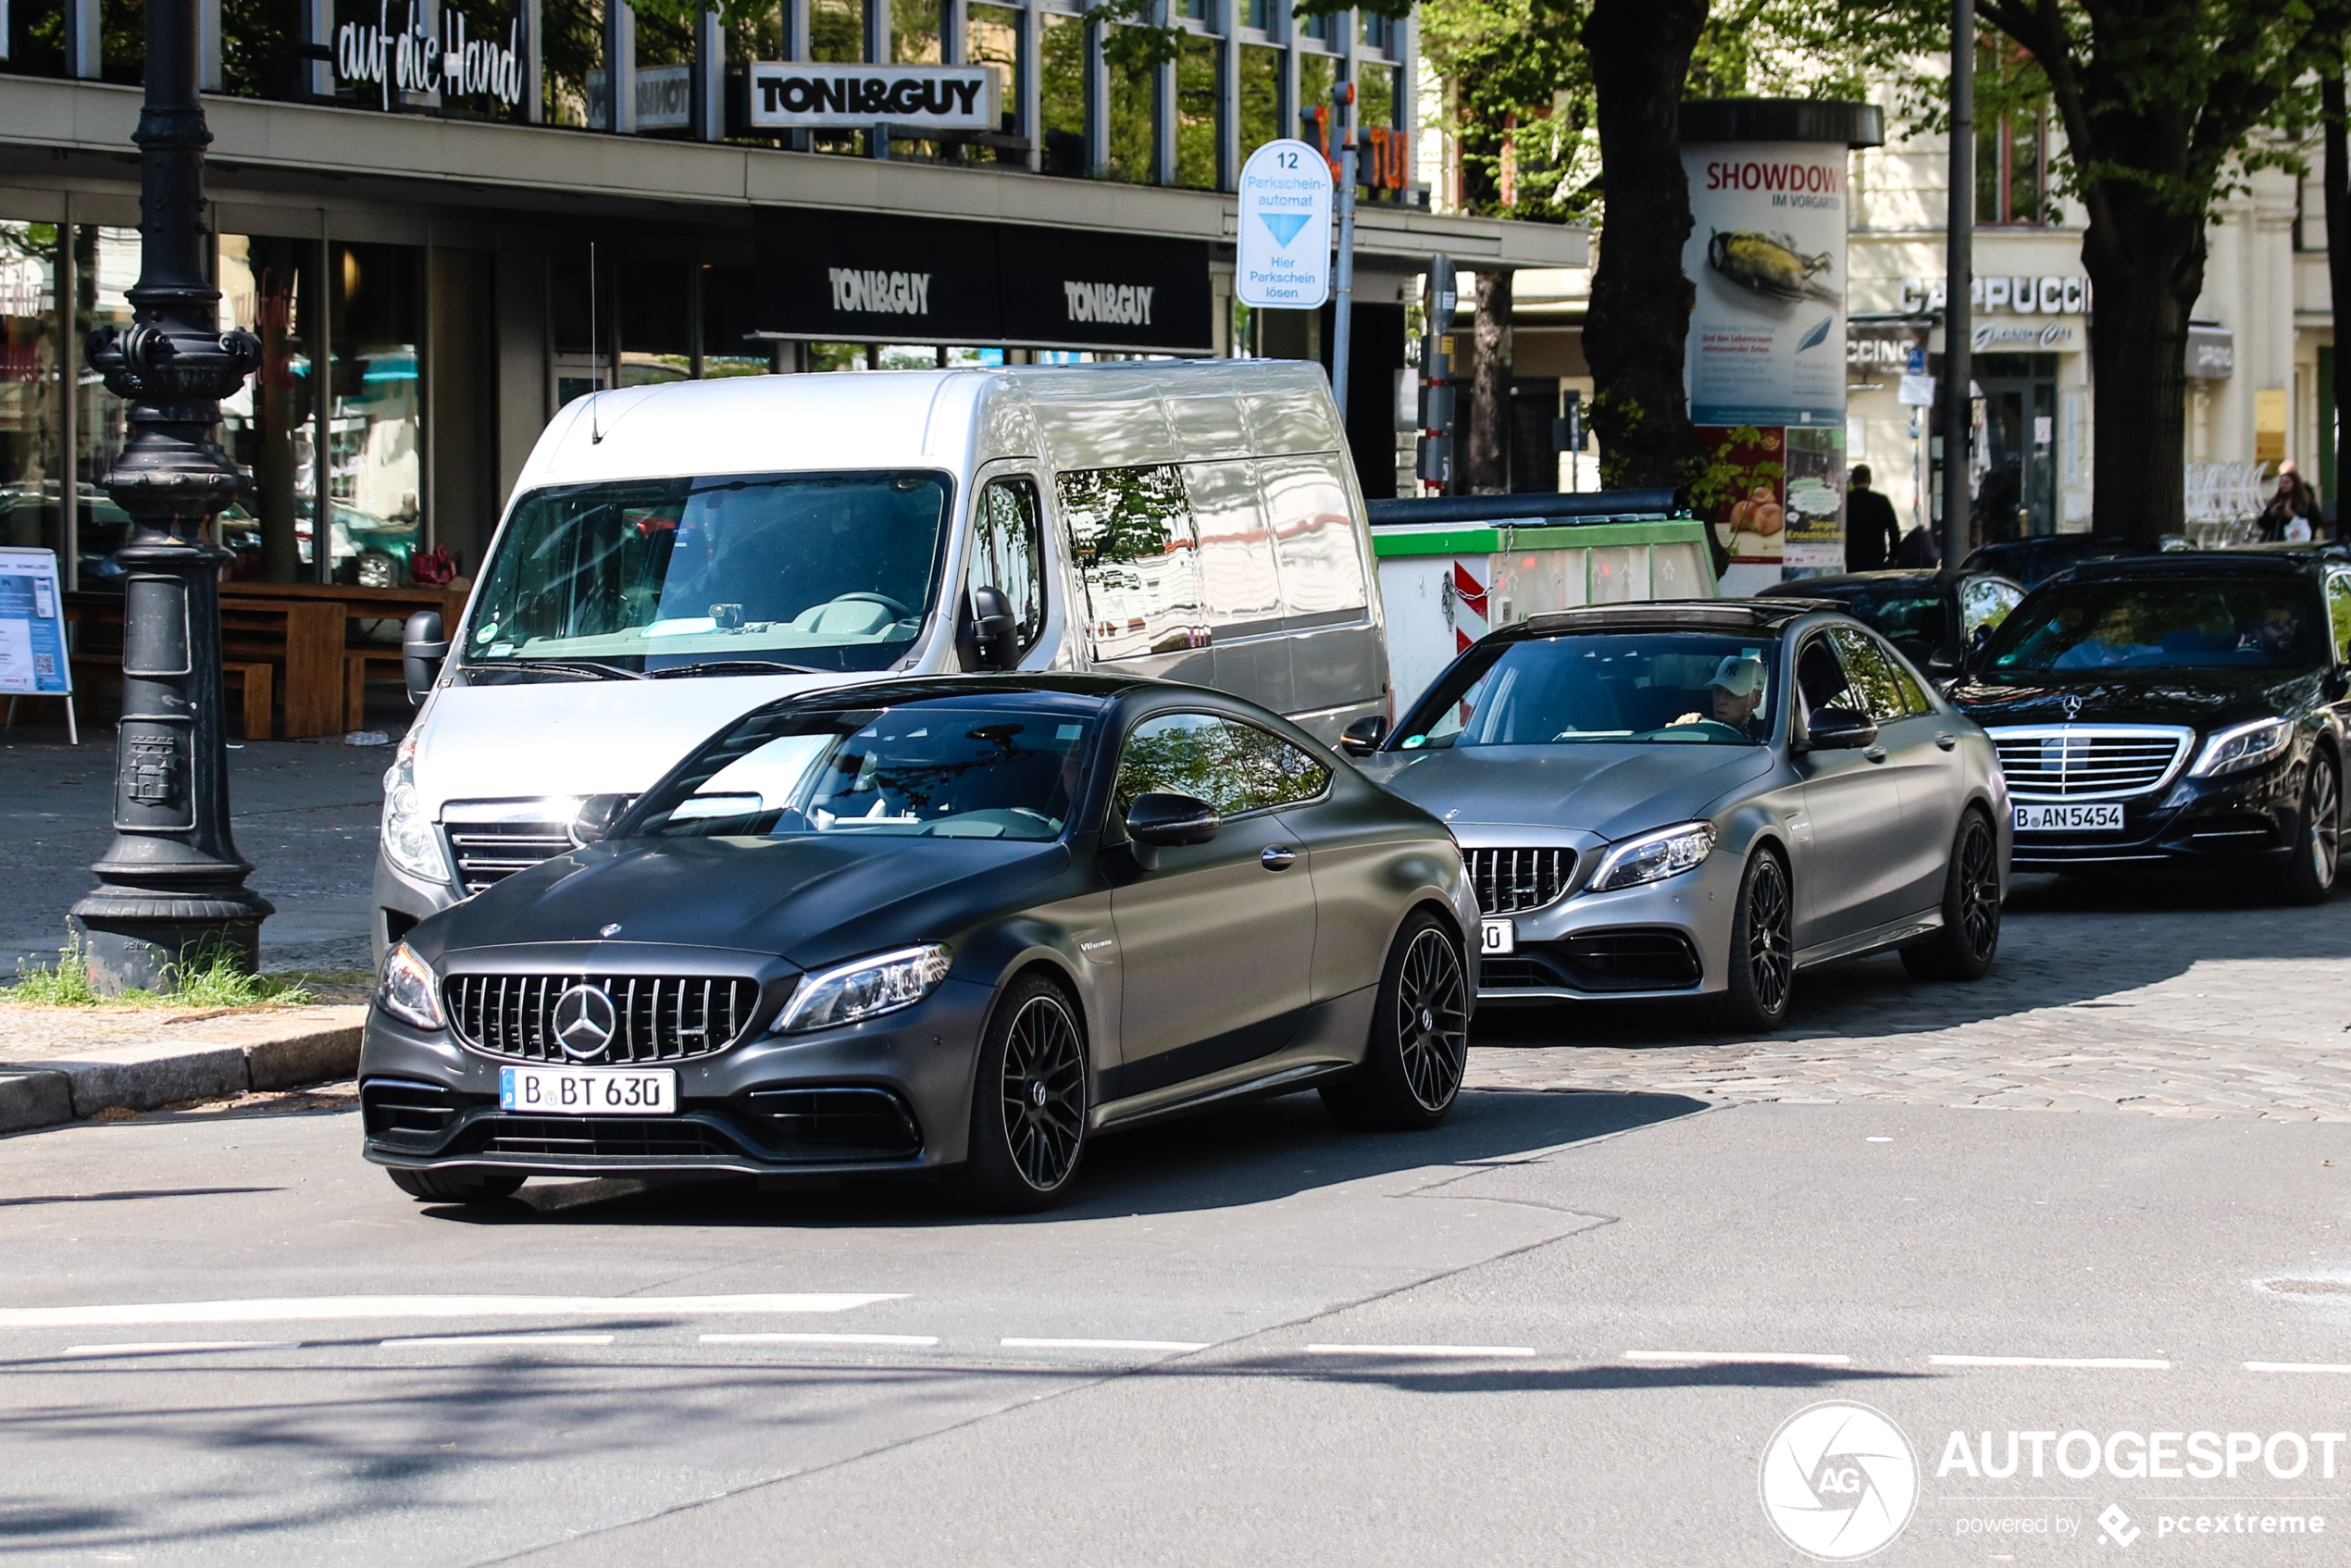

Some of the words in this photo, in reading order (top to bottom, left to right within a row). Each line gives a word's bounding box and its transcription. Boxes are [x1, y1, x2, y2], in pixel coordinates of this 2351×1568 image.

[339, 0, 394, 112] auf
[396, 0, 441, 93] die
[443, 8, 523, 105] Hand
[757, 77, 983, 115] TONI&GUY
[1277, 152, 1299, 168] 12
[1248, 176, 1326, 191] Parkschein-
[1258, 194, 1313, 206] automat
[1773, 194, 1786, 206] IM
[1271, 256, 1295, 268] Hier
[1250, 270, 1315, 283] Parkschein
[828, 268, 930, 315] TONI&GUY
[1266, 286, 1298, 298] lösen
[1064, 280, 1153, 325] TONI&GUY
[2017, 808, 2028, 827] B
[2042, 808, 2067, 827] AN
[2071, 807, 2120, 827] 5454
[525, 1076, 541, 1103] B
[561, 1077, 596, 1105] BT
[605, 1077, 660, 1106] 630
